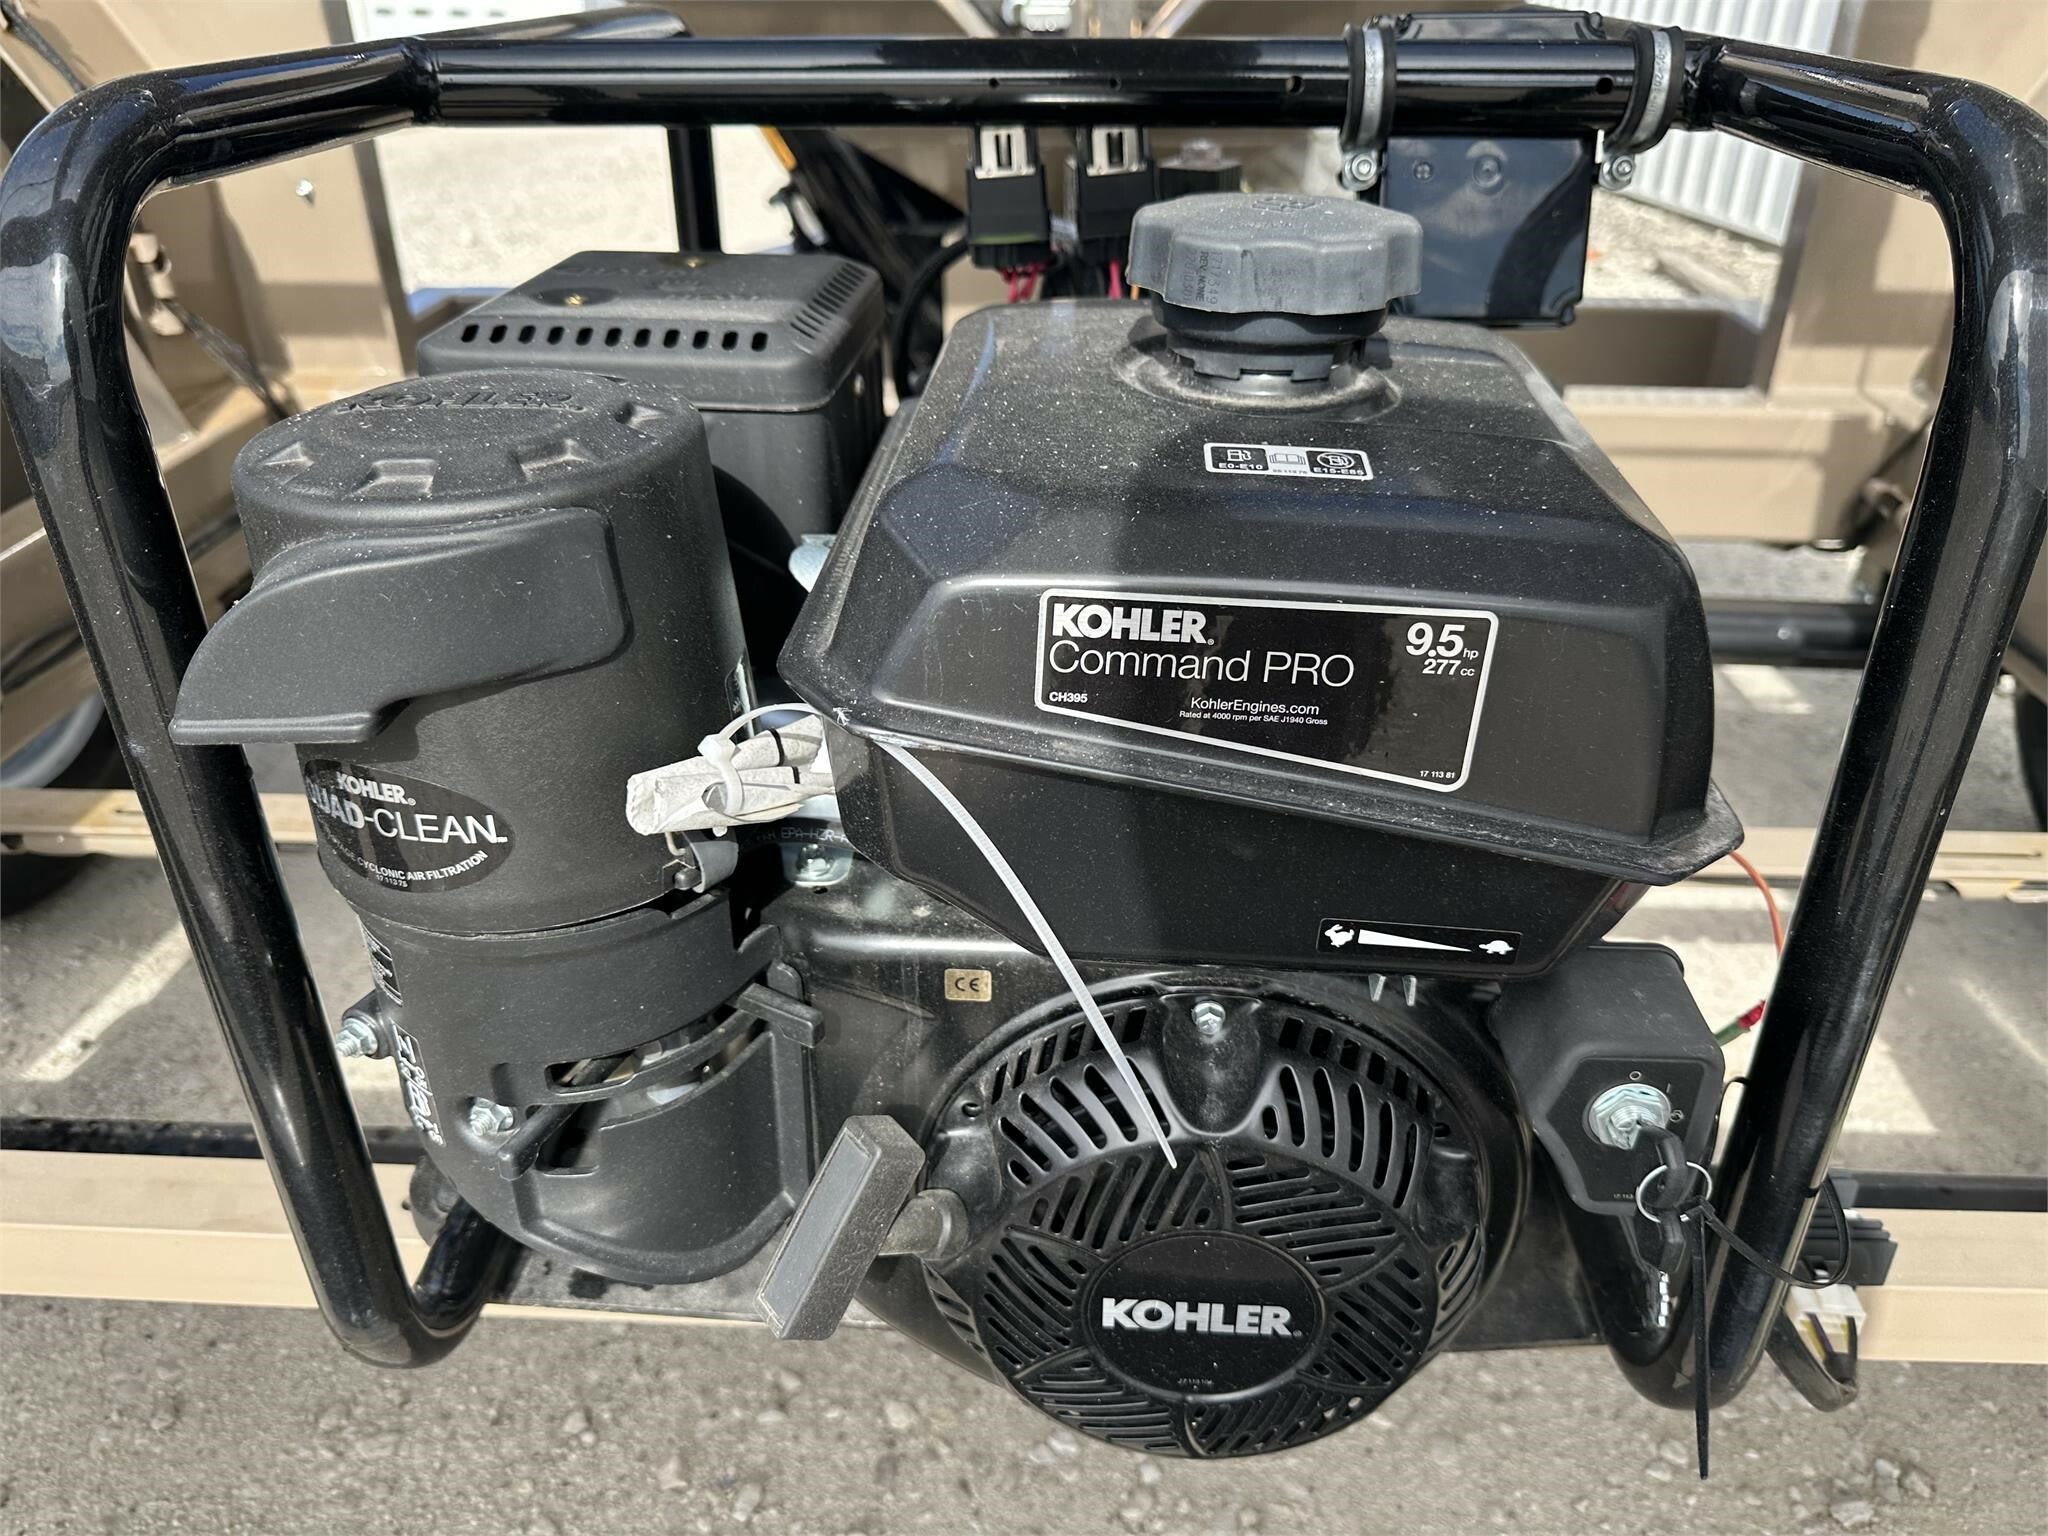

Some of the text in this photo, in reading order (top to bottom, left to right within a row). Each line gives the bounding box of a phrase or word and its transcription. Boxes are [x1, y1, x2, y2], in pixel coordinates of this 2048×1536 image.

[1218, 462, 1264, 470] E0-E10
[1052, 603, 1207, 644] KOHLER
[1405, 622, 1479, 660] 9.5 hp
[1050, 640, 1355, 687] Command PRO
[1422, 659, 1475, 677] 277 cc
[1049, 691, 1088, 704] CH395
[1191, 697, 1320, 715] KohlerEngines.com
[1179, 710, 1202, 719] Rated
[1212, 712, 1231, 720] 4000
[1232, 714, 1248, 723] rpm
[1249, 715, 1262, 723] per
[1262, 714, 1280, 723] SAE
[1281, 716, 1304, 724] J1940
[1305, 717, 1328, 726] Gross
[1445, 771, 1456, 779] 81
[357, 850, 488, 881] CYCLONIC AIR FILTRATION
[1102, 1297, 1293, 1337] KOHLER
